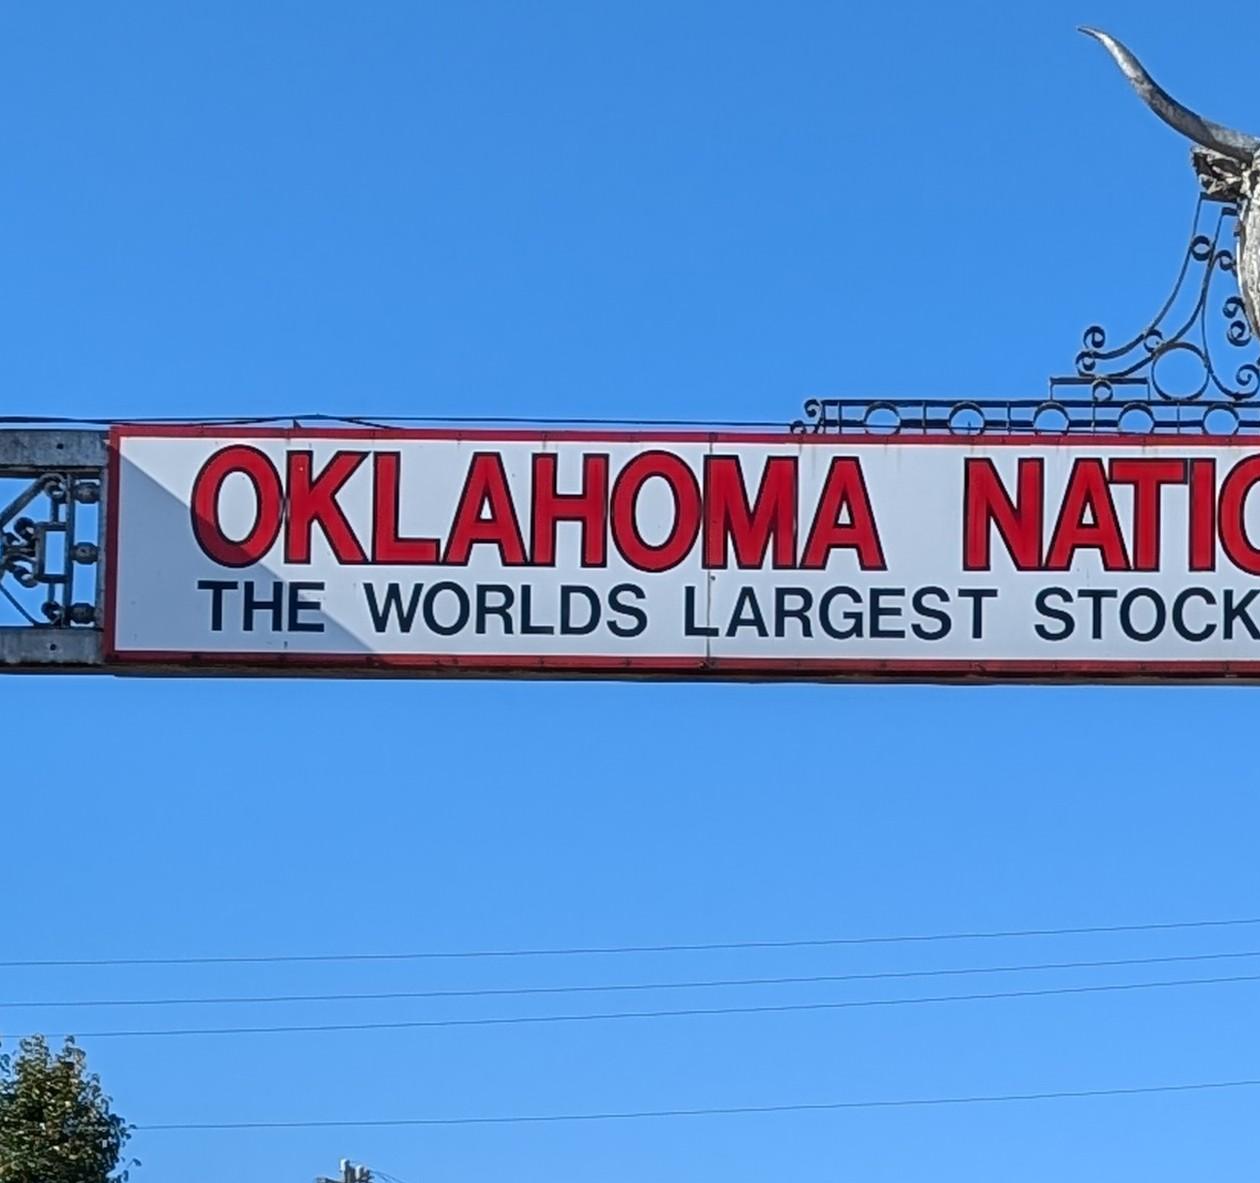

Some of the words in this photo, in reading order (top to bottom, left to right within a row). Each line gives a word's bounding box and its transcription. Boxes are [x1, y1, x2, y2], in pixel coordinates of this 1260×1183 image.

[191, 444, 887, 572] OKLAHOMA
[198, 581, 325, 632] THE
[364, 581, 648, 638] WORLDS
[685, 587, 998, 640] LARGEST
